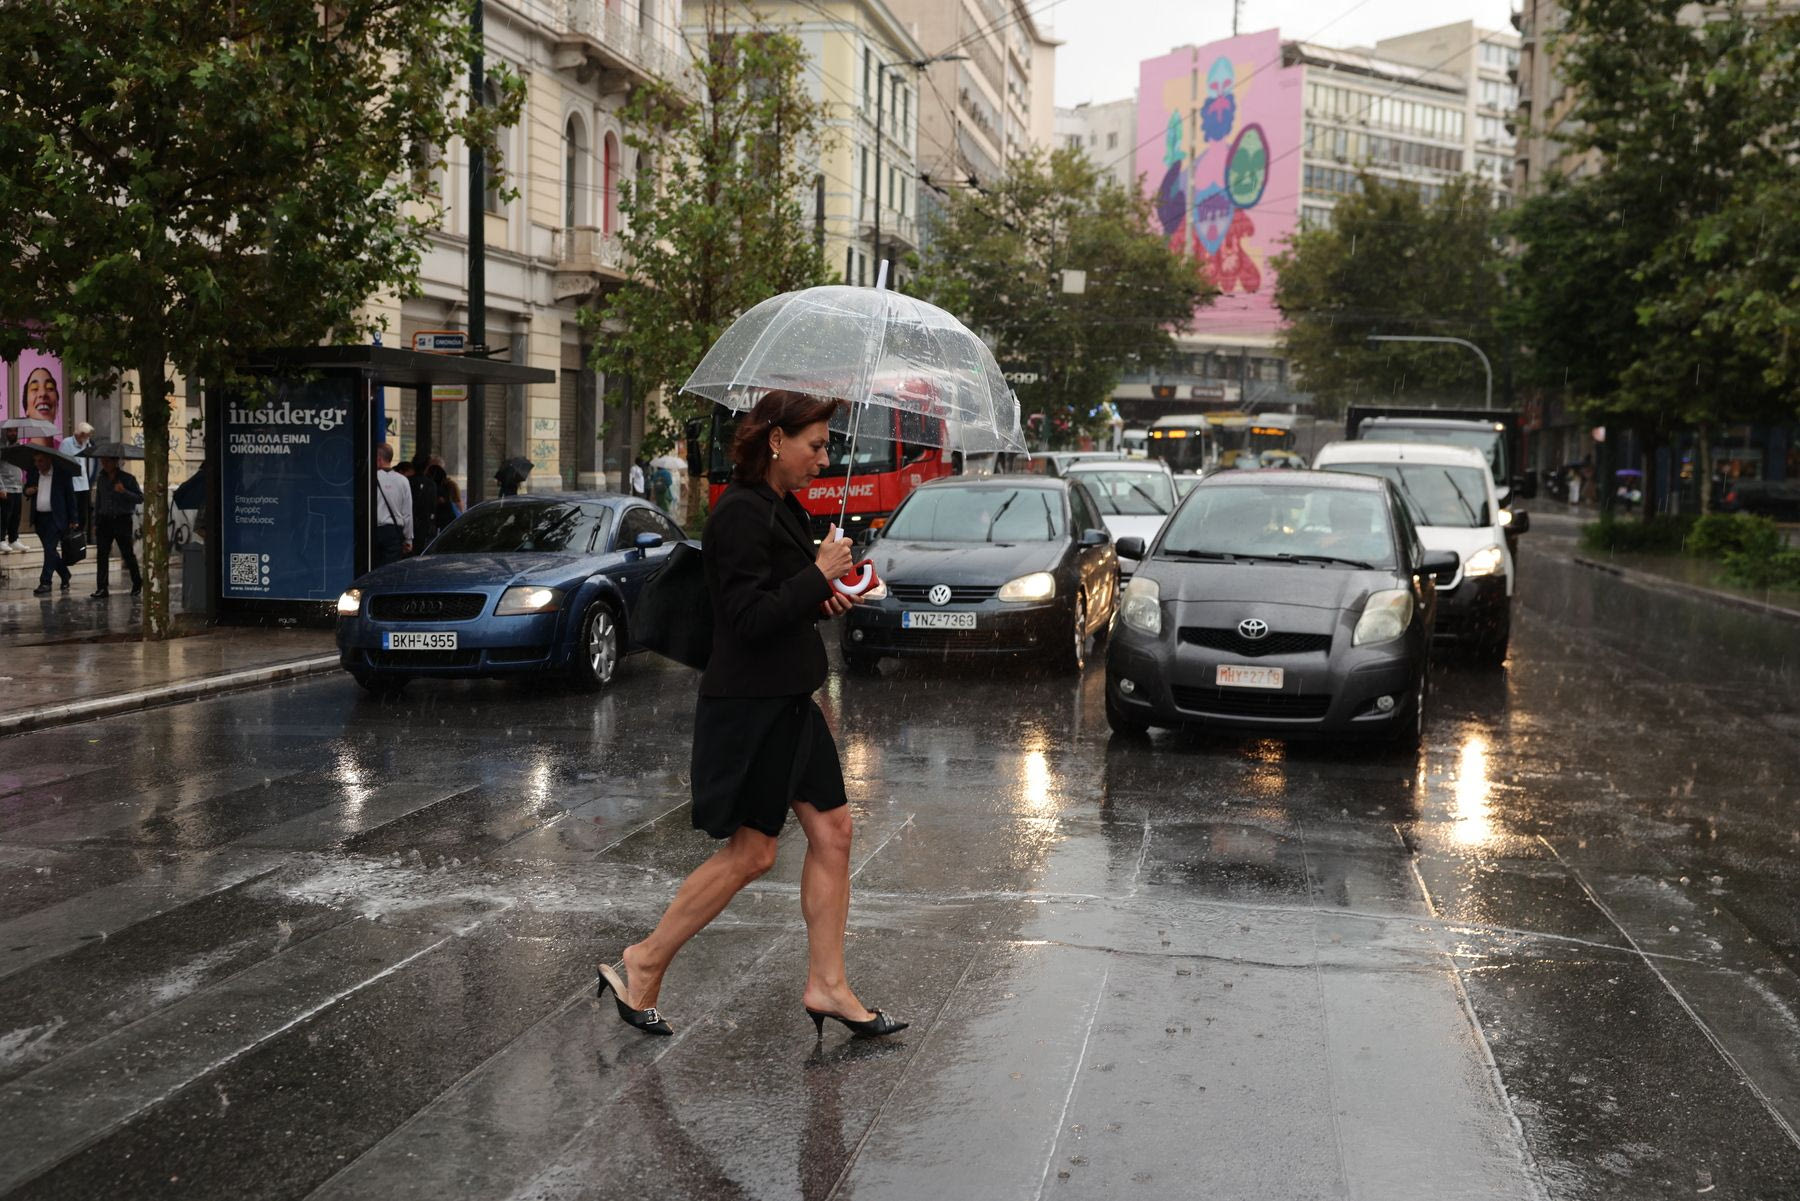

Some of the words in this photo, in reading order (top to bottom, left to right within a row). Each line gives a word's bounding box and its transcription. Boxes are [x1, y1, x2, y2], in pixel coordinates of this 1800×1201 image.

[229, 401, 347, 431] insider.gr
[230, 434, 255, 444] ΓΙΑΤΙ
[257, 434, 281, 444] ΟΛΑ
[282, 434, 310, 444] ΕΙΝΑΙ
[230, 444, 291, 454] ΟΙΚΟΝΟΜΙΑ
[808, 484, 874, 499] ΒΡΑΧΝΗΣ
[235, 505, 261, 515] Αγορές
